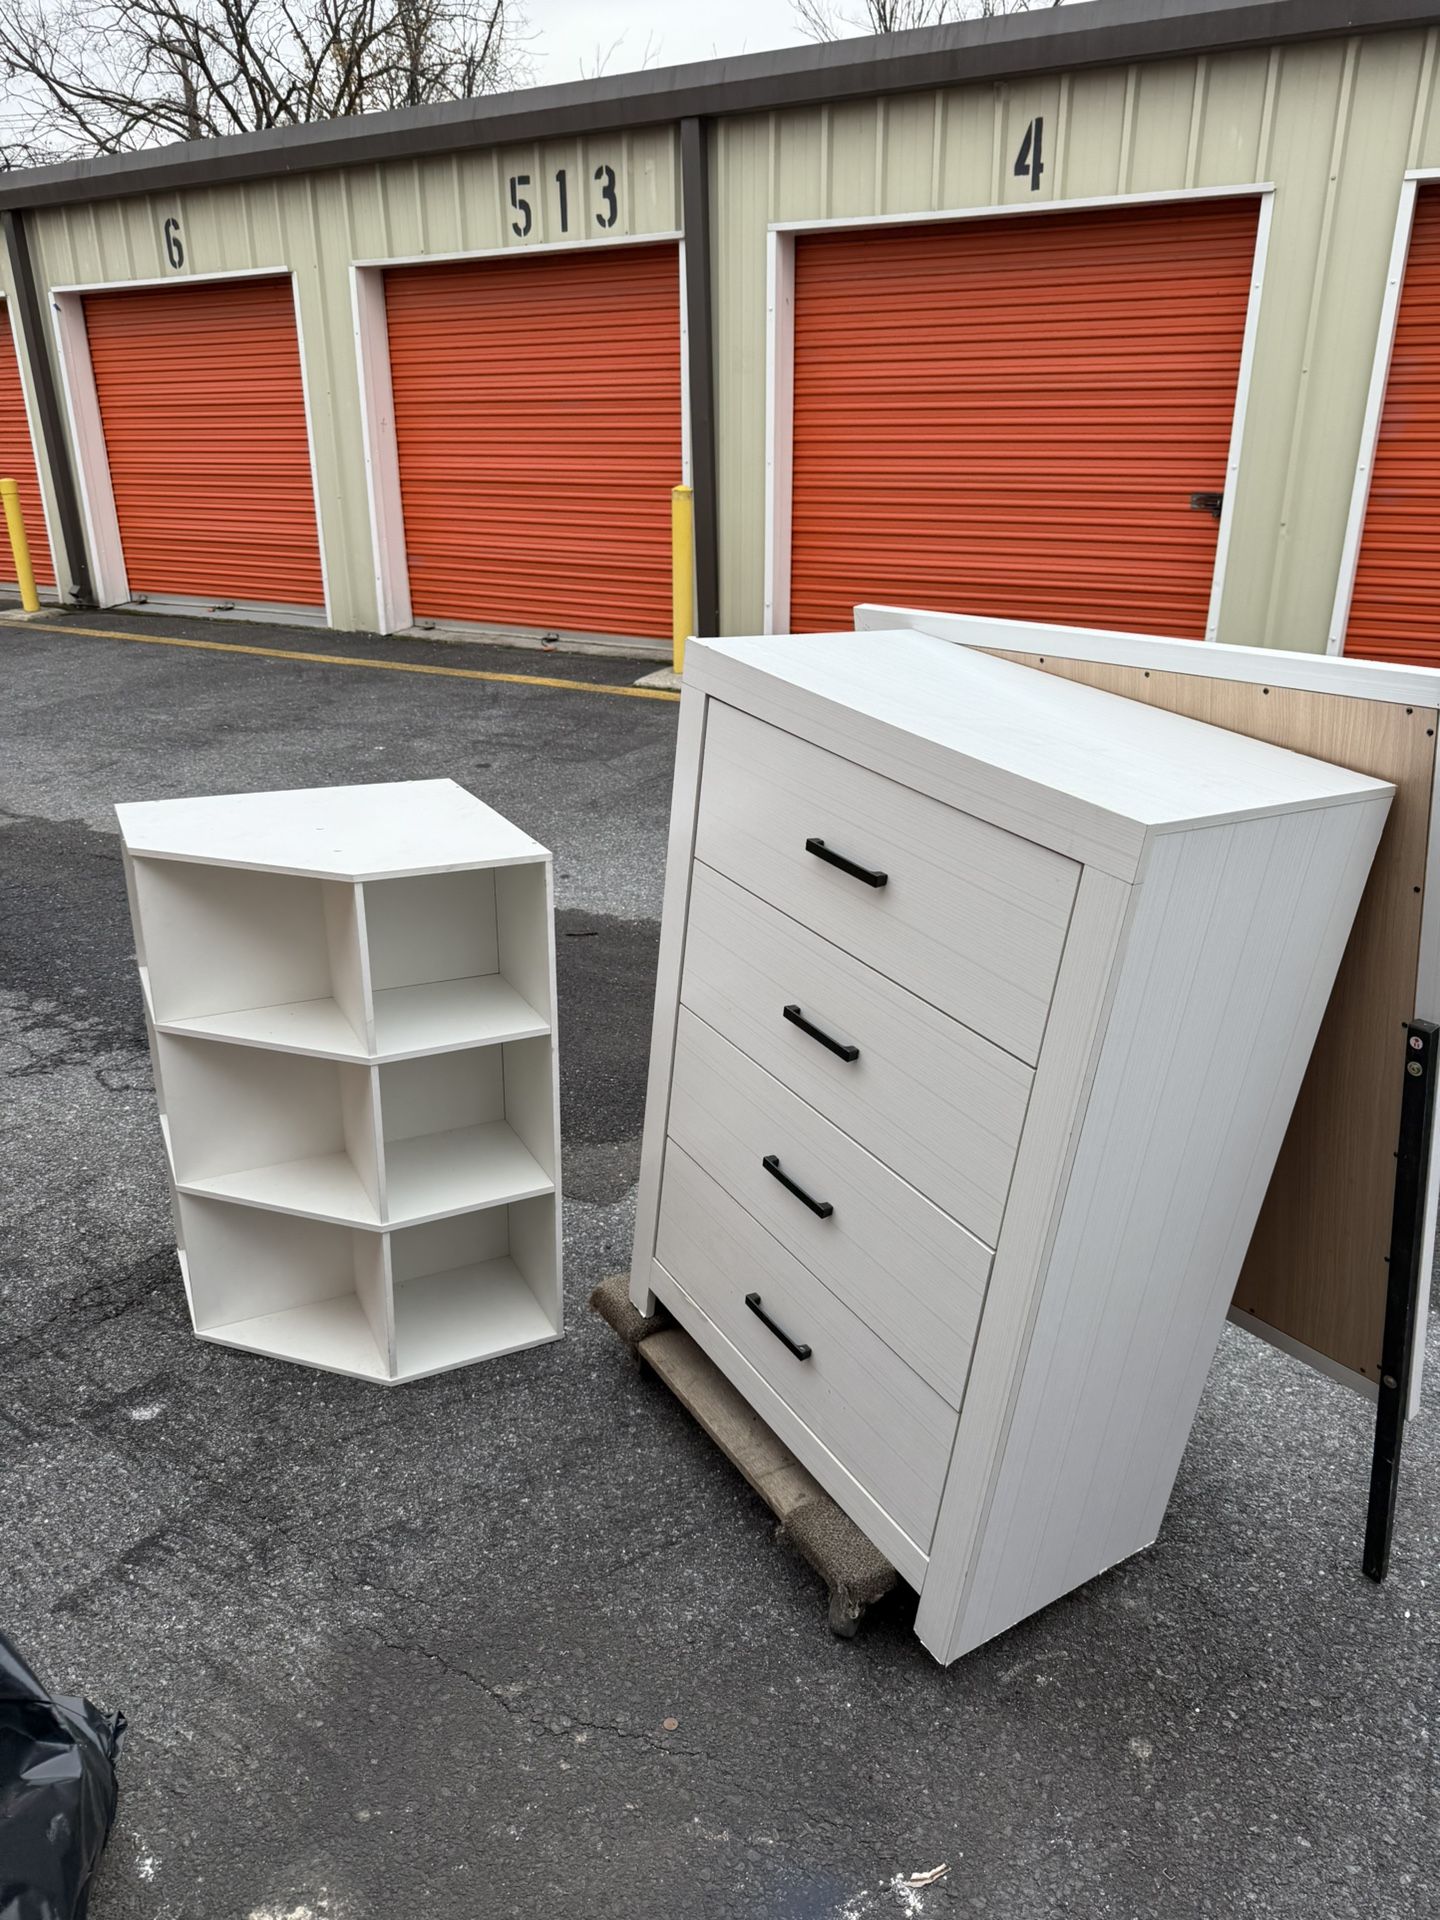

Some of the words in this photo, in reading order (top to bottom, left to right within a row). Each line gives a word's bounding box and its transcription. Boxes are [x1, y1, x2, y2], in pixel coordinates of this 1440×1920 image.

[1014, 116, 1045, 191] 4
[509, 164, 619, 238] 513
[164, 217, 184, 270] 6
